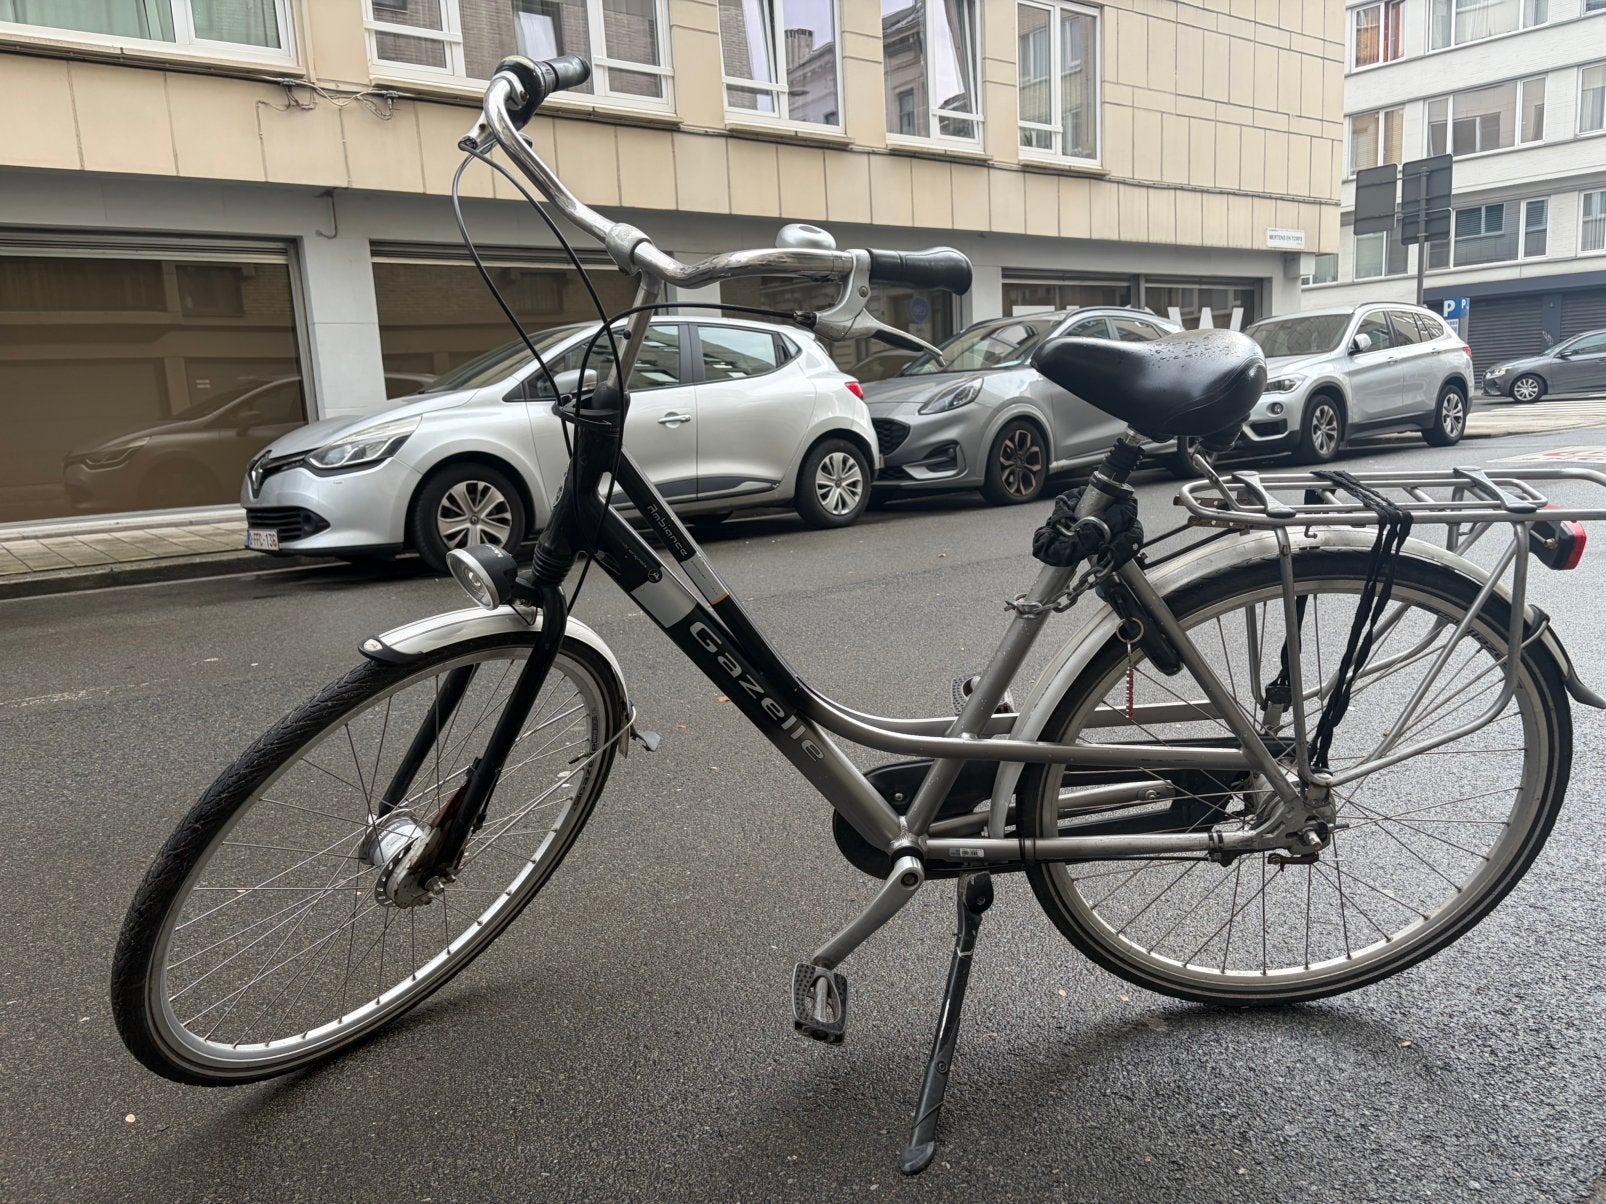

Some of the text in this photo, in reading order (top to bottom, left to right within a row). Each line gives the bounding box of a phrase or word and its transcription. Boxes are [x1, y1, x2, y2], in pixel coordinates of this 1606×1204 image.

[1443, 299, 1456, 318] P
[1461, 299, 1467, 309] P
[647, 503, 688, 557] Ambiance
[689, 621, 824, 762] Gazelle
